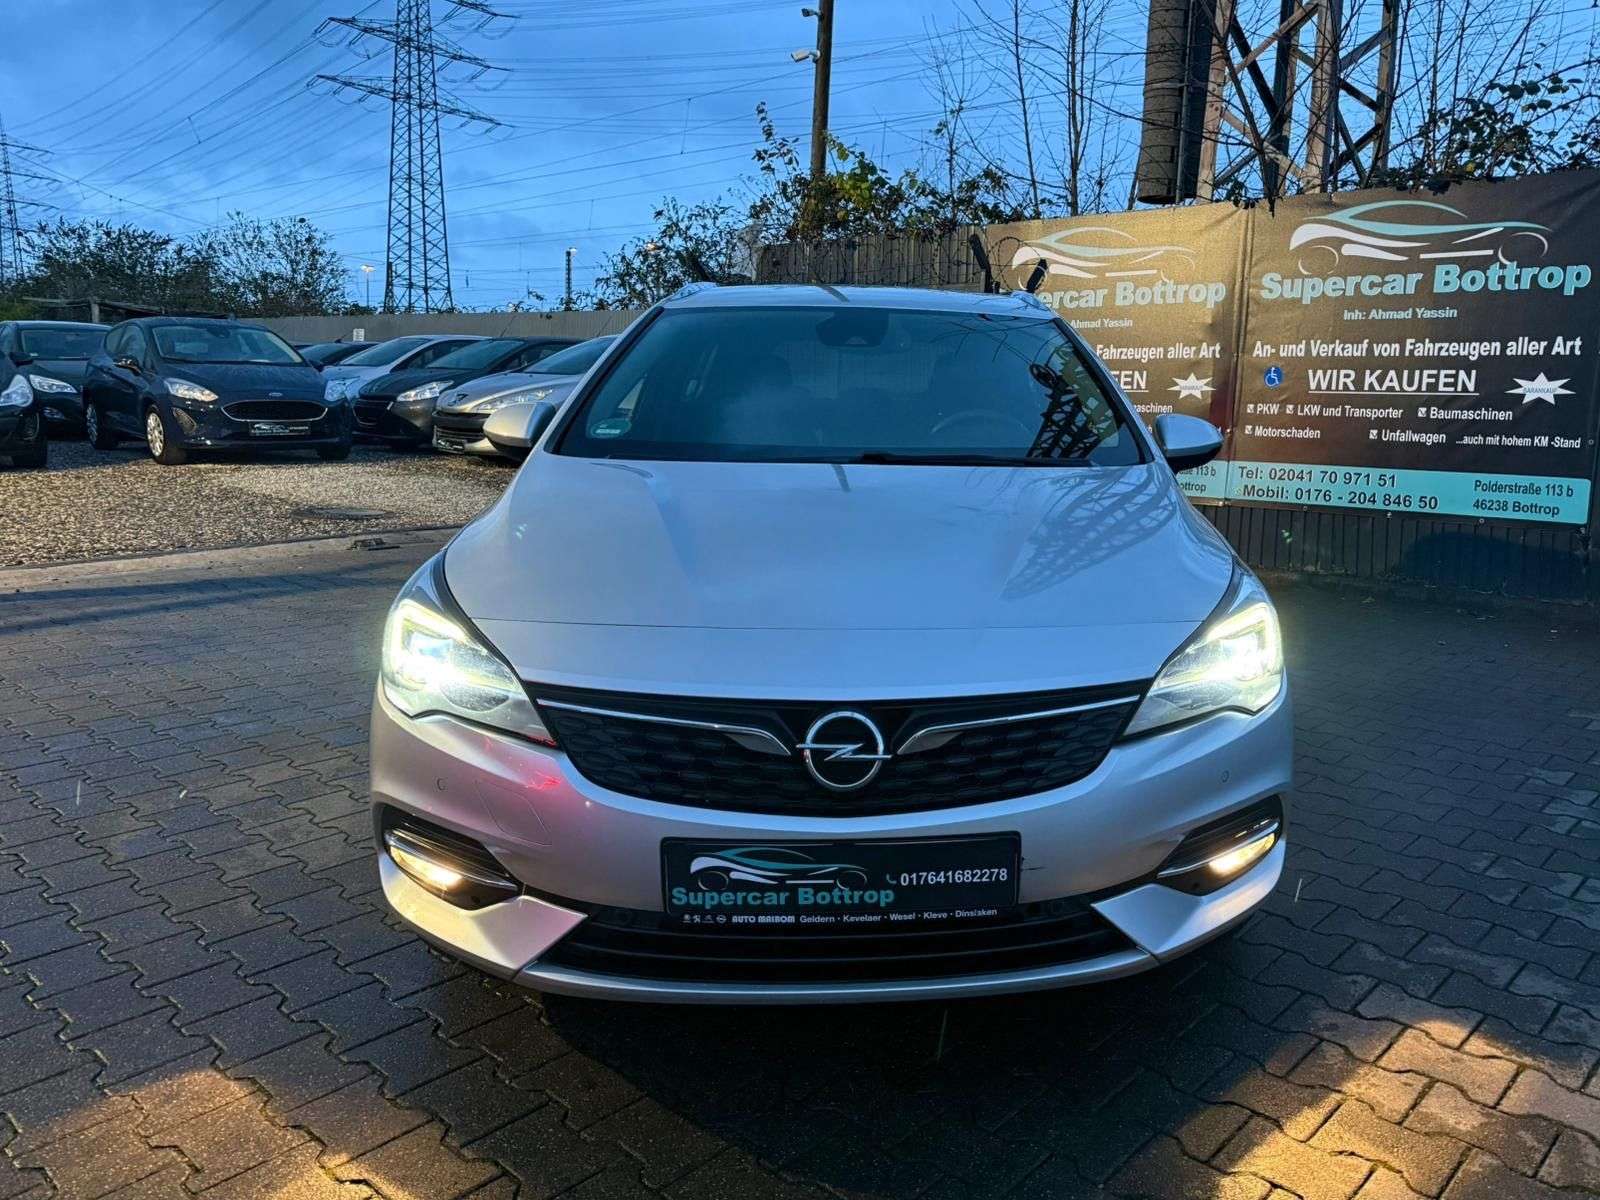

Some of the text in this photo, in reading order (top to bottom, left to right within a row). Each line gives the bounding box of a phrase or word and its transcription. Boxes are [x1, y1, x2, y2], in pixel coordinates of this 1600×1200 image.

[1260, 261, 1592, 304] Supercar Bottrop
[1039, 281, 1227, 309] ercar Bottrop
[1343, 306, 1458, 320] Inh: Ahmad Yassin
[1071, 317, 1133, 329] Ahmad Yassin
[1096, 342, 1220, 363] Fahrzeugen aller Art
[1252, 335, 1582, 361] An- und Verkauf von Fahrzeugen aller Art
[1308, 369, 1477, 392] WIR KAUFEN
[1134, 402, 1173, 413] aschinen
[1256, 403, 1279, 415] PKW
[1297, 404, 1403, 420] LKW und Transporter
[1430, 407, 1513, 421] Baumaschinen
[1254, 425, 1321, 439] Motorschaden
[1381, 429, 1446, 445] Unfallwagen
[1486, 434, 1499, 446] mit
[1501, 435, 1532, 447] hohem
[1534, 436, 1548, 447] KM
[1238, 466, 1397, 488] Tel: 02041 70 971 51
[1180, 482, 1207, 494] ottrop
[1474, 480, 1574, 498] Polderstraße 113 b
[1243, 484, 1289, 499] Mobil:
[1295, 487, 1332, 502] 0176
[1349, 491, 1377, 505] 204
[1382, 493, 1412, 507] 846
[1418, 496, 1439, 510] 50
[1472, 499, 1560, 518] 46238 Bottrop
[899, 868, 1008, 886] 017641682278
[671, 886, 895, 909] Supercar Bottrop
[732, 915, 756, 923] AUTO
[923, 911, 948, 919] Kleve
